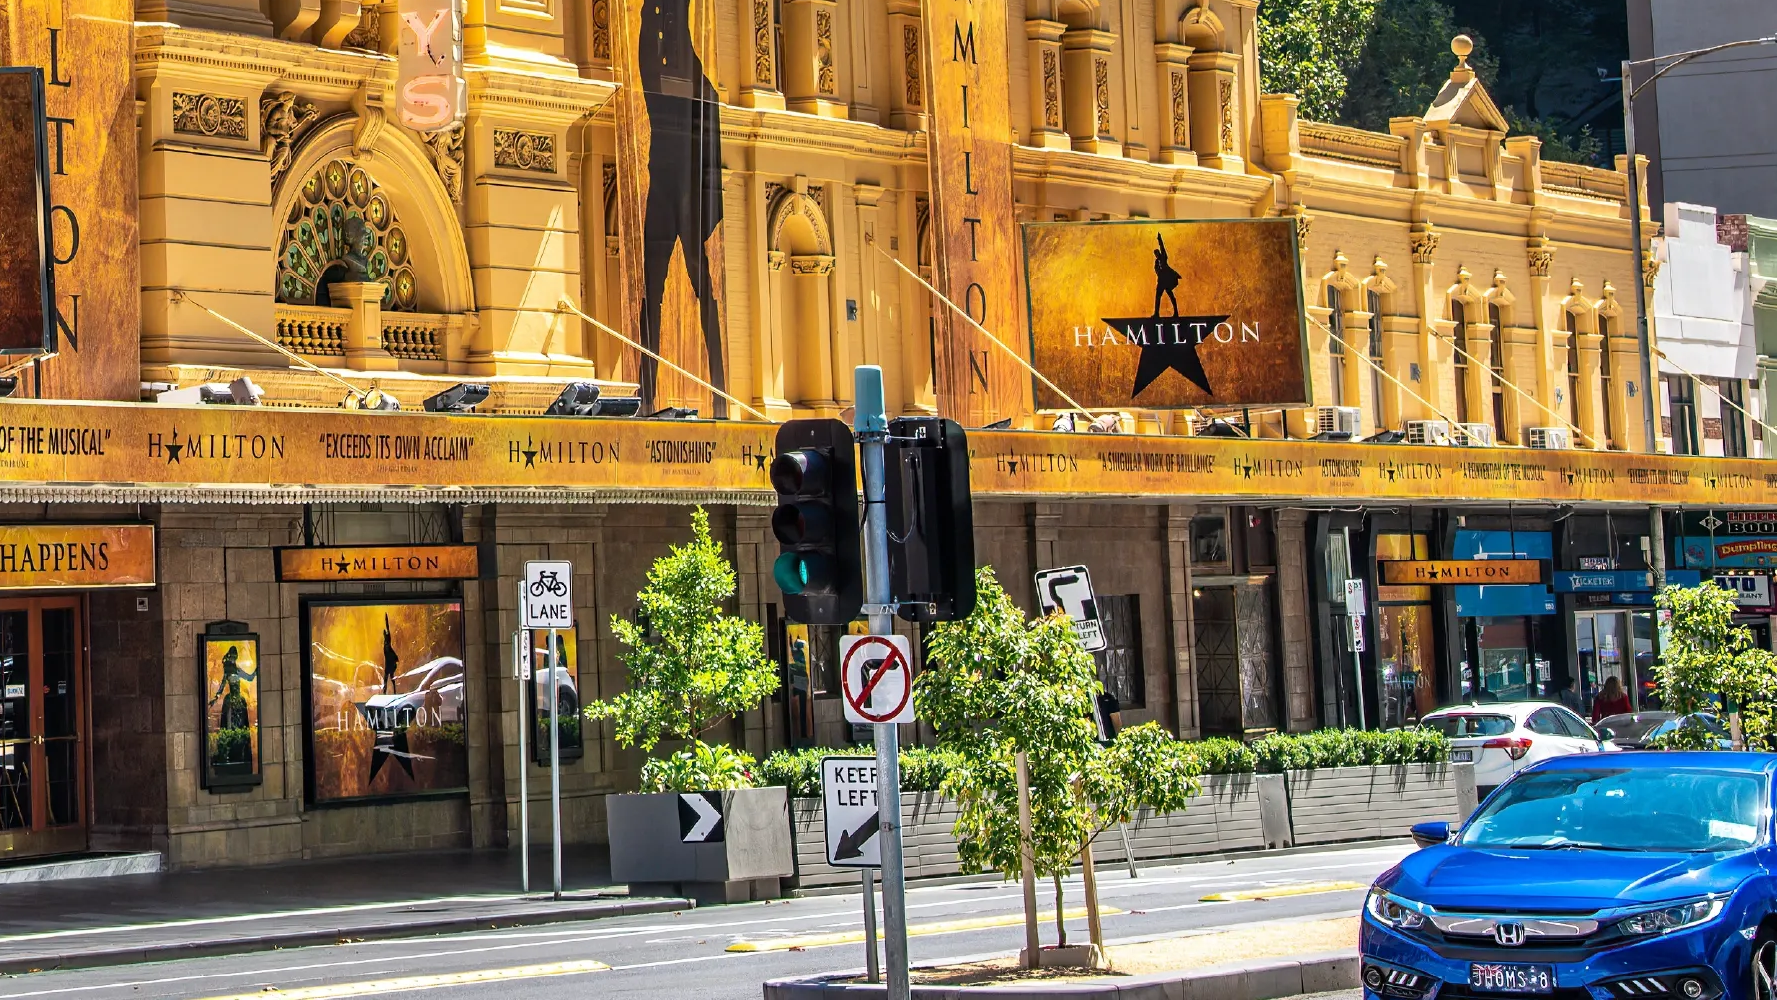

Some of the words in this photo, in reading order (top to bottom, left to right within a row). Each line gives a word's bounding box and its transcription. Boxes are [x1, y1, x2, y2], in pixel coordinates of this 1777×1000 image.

[1074, 321, 1260, 347] HAMILTON
[21, 427, 44, 455] THE
[48, 429, 111, 456] MUSICAL"
[320, 433, 371, 459] "EXCEEDS
[375, 435, 391, 460] ITS
[395, 435, 420, 460] OWN
[423, 436, 474, 461] ACCLAIM"
[1144, 452, 1164, 473] WORK
[0, 542, 110, 574] HAPPENS
[530, 604, 567, 619] LANE
[337, 706, 442, 731] HAMILTON
